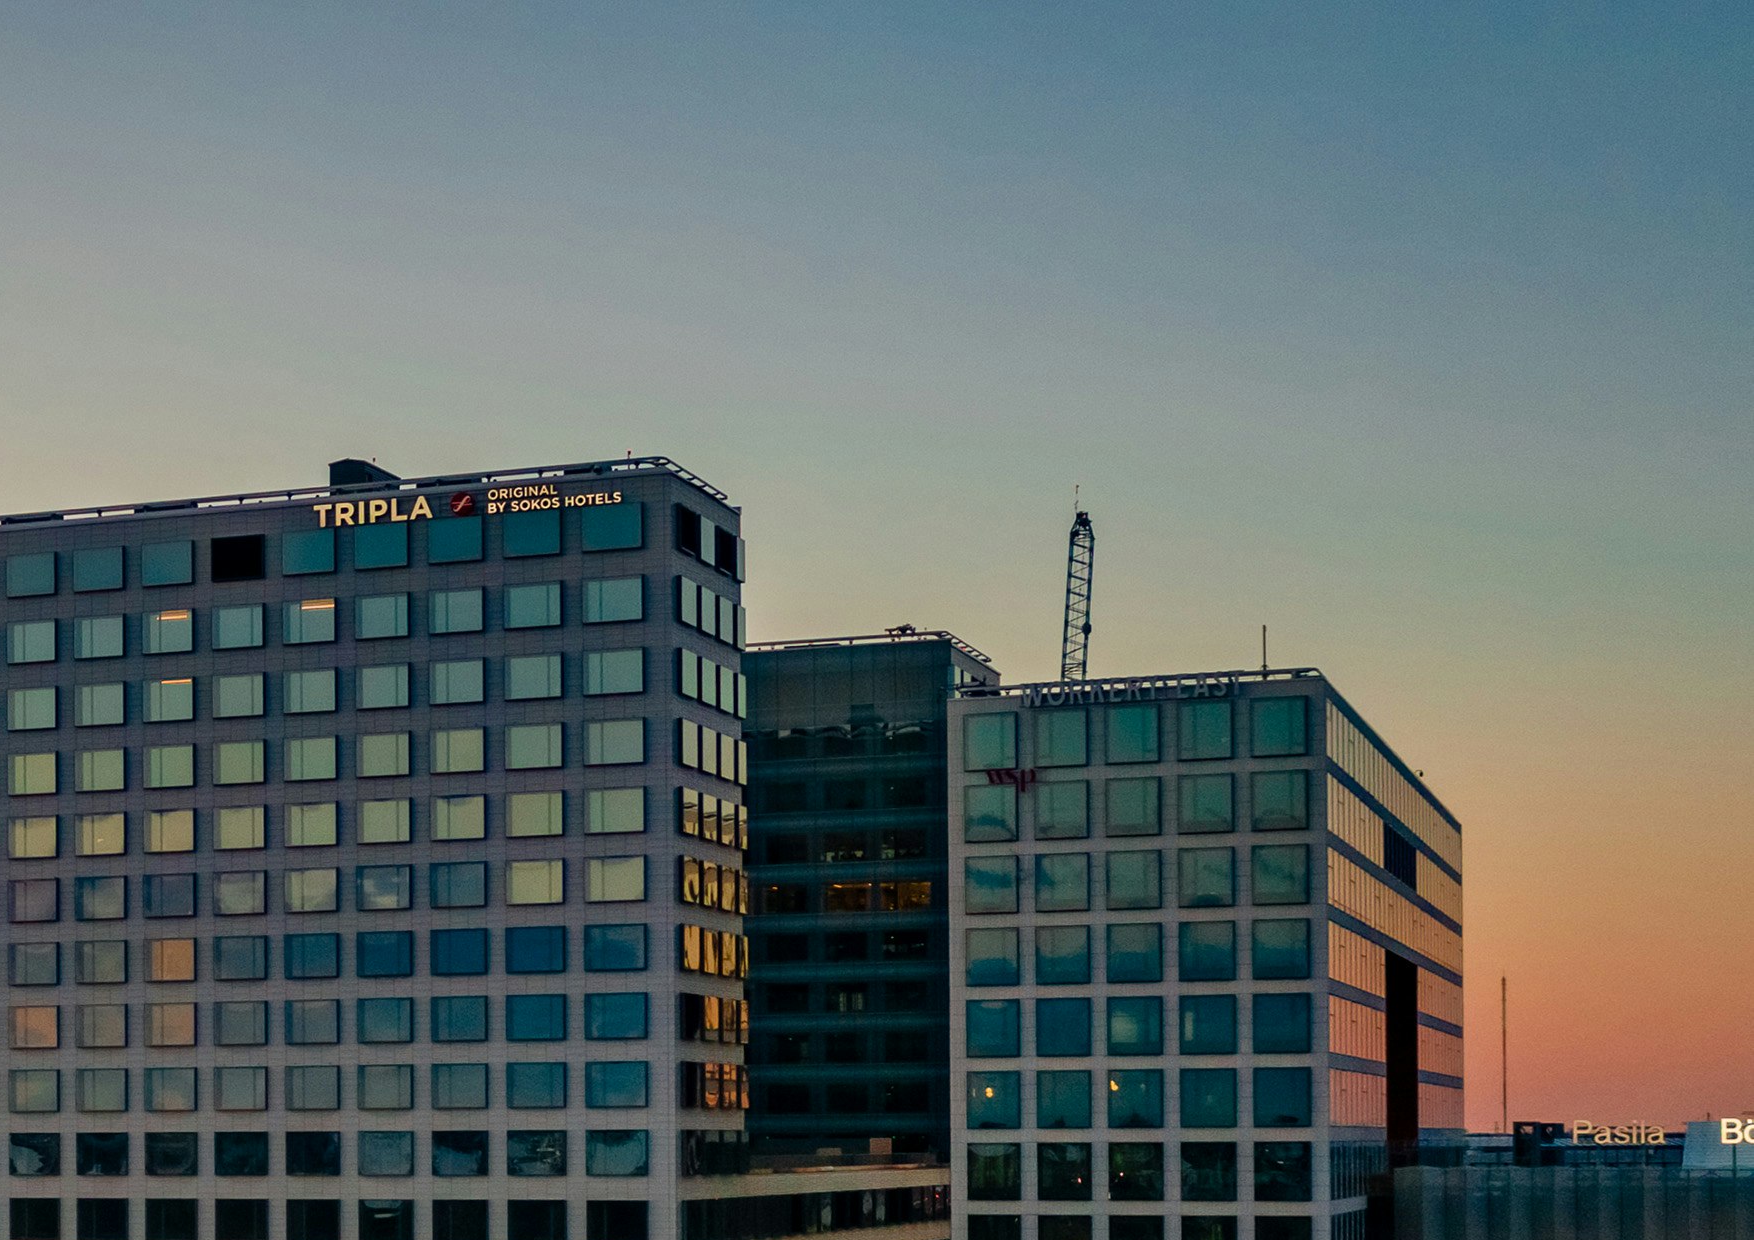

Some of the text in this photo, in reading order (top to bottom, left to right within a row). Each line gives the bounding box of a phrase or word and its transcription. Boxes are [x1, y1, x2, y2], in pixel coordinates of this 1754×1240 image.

[487, 484, 558, 500] ORIGINAL
[487, 491, 622, 514] BY SOKOS HOTELS
[313, 495, 434, 528] TRIPLA
[1020, 673, 1243, 707] WORKERY EAST
[1572, 1119, 1666, 1145] Pasila
